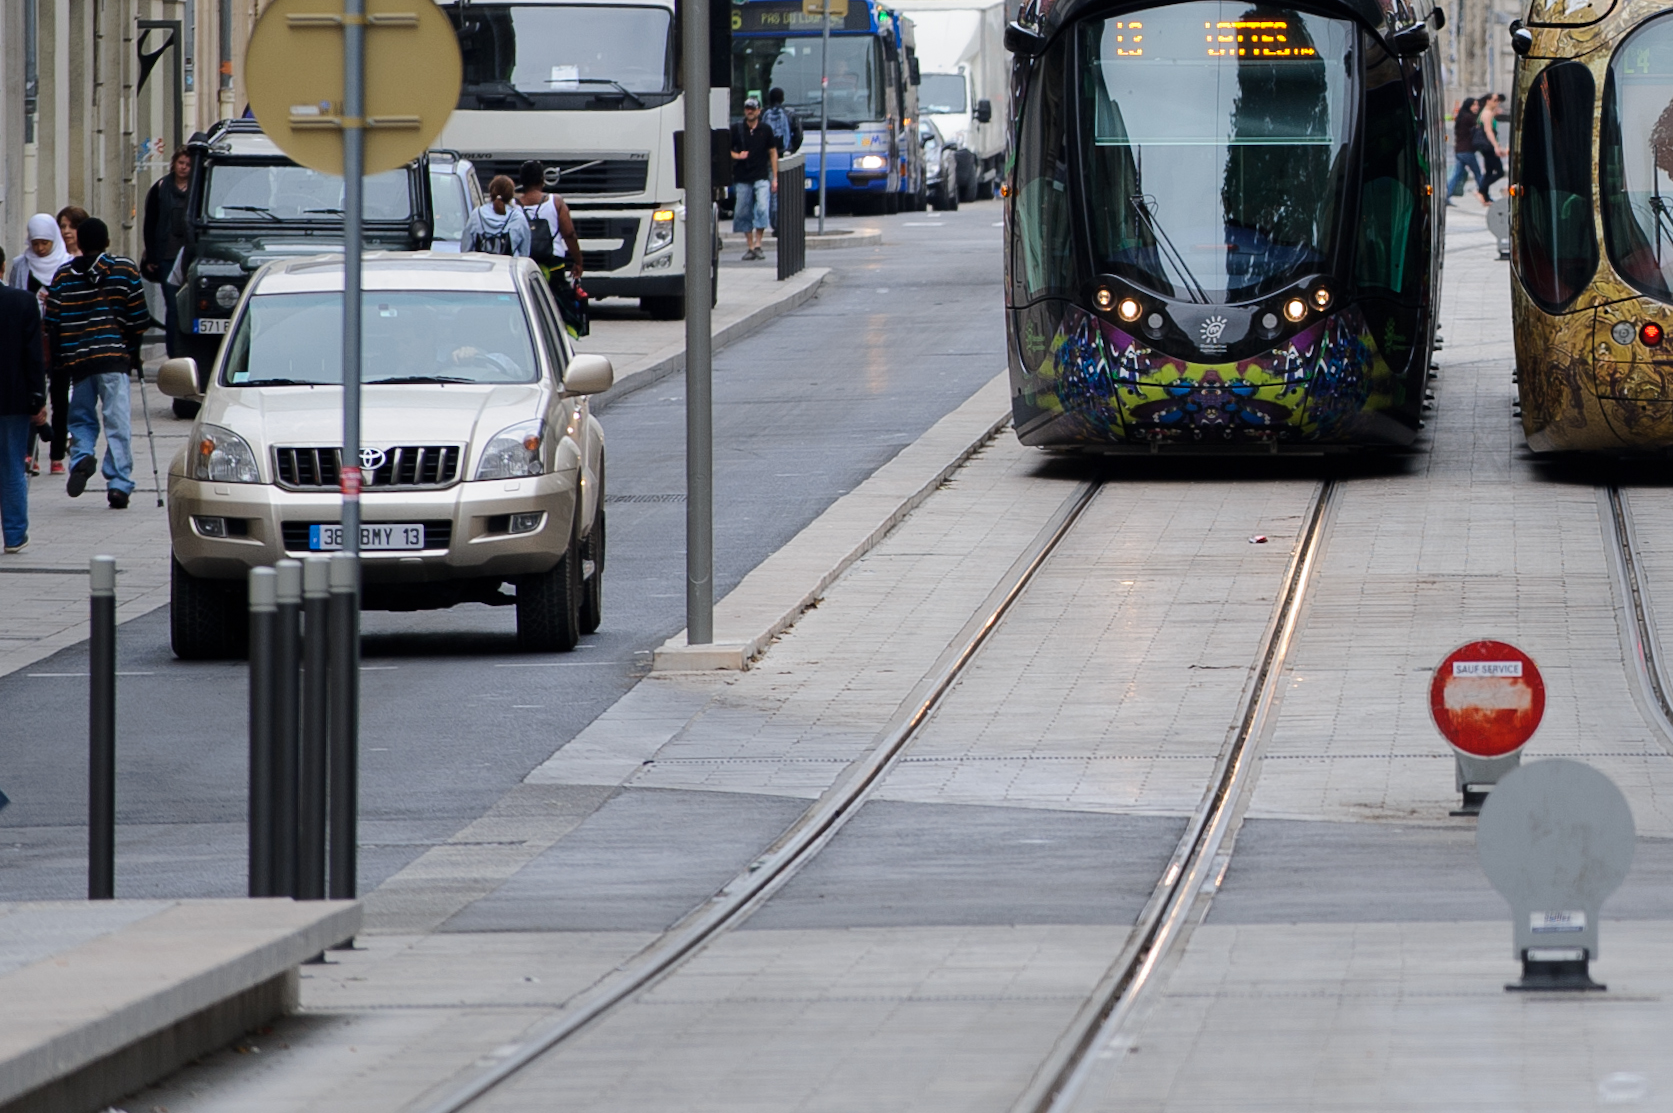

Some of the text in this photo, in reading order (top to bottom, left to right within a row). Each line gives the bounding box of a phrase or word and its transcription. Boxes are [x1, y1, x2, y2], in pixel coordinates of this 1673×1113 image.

[1623, 48, 1650, 74] L4
[200, 320, 220, 332] 571
[324, 528, 420, 545] 38 BMY 13
[1456, 664, 1520, 675] SAUF SERVICE
